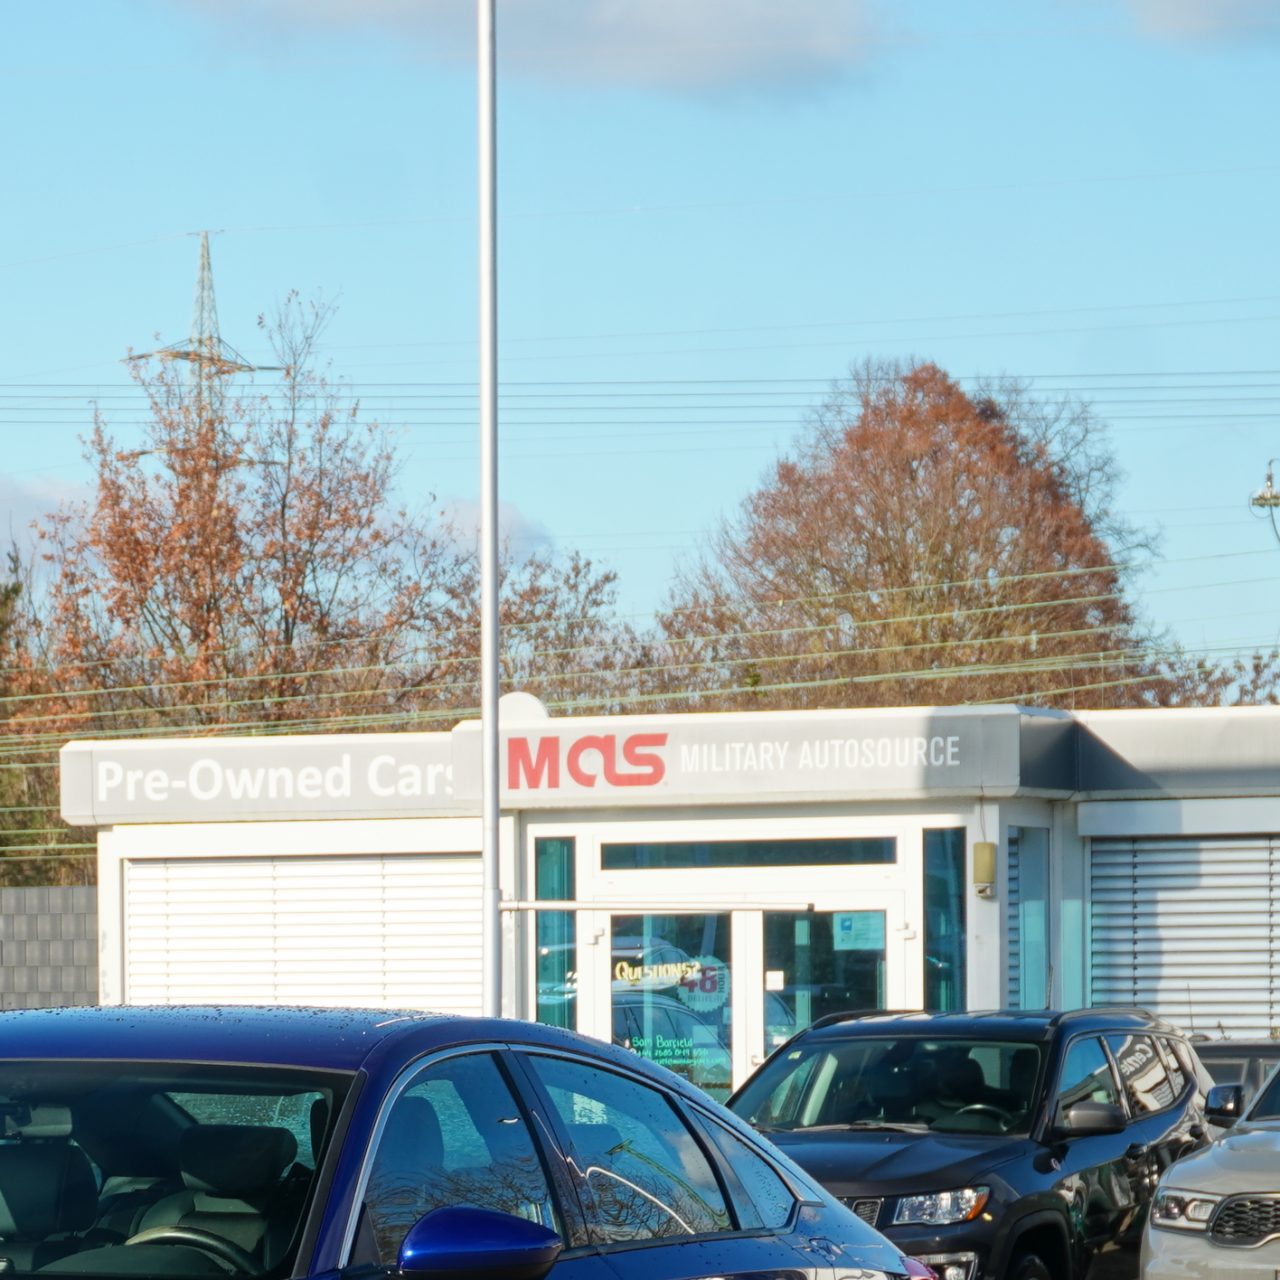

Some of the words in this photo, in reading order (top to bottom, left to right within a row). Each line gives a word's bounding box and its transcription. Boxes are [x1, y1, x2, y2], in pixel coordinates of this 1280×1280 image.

[681, 740, 790, 774] MILITARY
[798, 736, 960, 769] AUTOSOURCE
[97, 754, 352, 802] Pre-Owned
